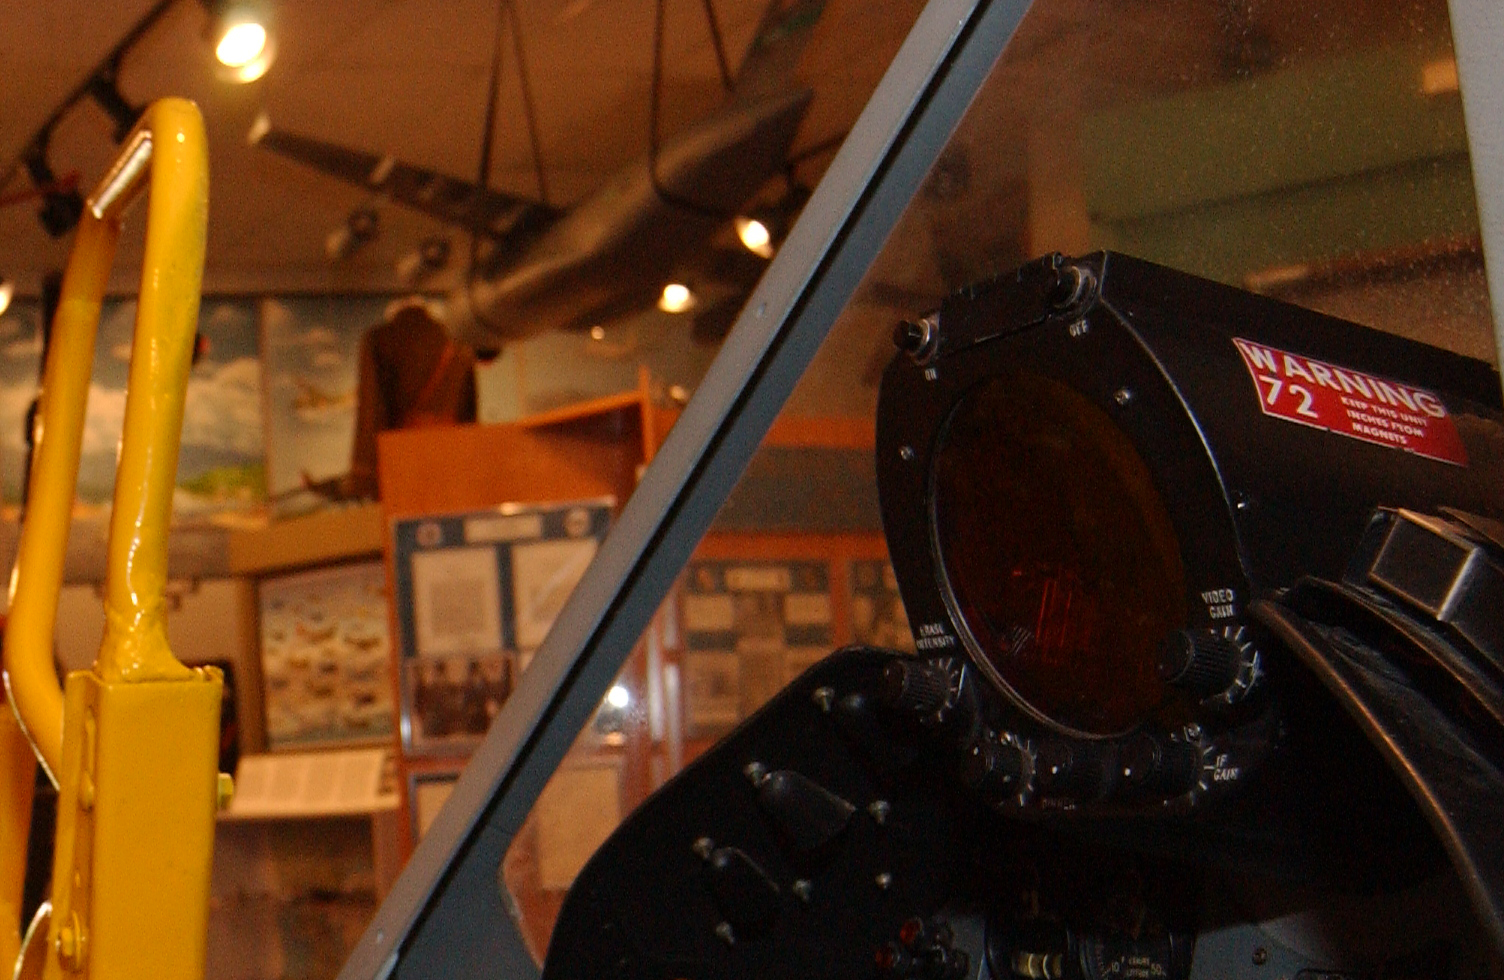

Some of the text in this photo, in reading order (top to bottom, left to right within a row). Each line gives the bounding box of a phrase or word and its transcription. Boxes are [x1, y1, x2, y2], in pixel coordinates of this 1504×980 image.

[1239, 340, 1447, 419] WARNING
[1259, 374, 1319, 419] 72
[1340, 395, 1428, 428] KEEP THIS UNIT
[1346, 409, 1388, 430] INCHES
[1351, 422, 1409, 445] MAGNETS
[1200, 587, 1236, 605] VIDEO
[1208, 603, 1236, 619] GAIN
